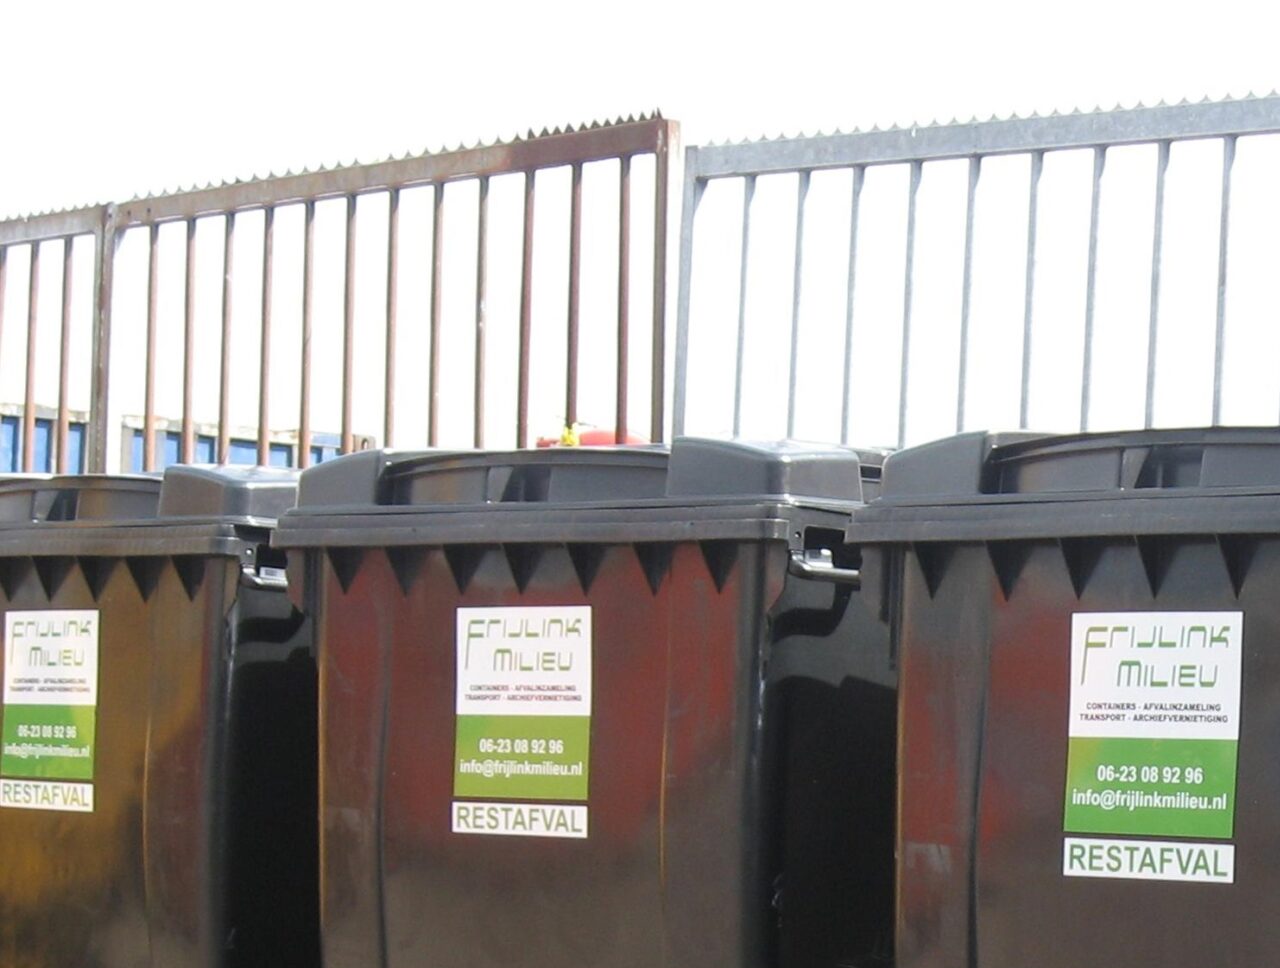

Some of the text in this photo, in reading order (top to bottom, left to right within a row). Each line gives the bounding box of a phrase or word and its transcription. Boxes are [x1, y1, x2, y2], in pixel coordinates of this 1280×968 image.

[1086, 702, 1136, 711] CONTAINERS
[1143, 703, 1221, 712] AFVALINZAMELING
[1080, 714, 1126, 722] TRANSPORT
[1133, 714, 1228, 723] ARCHIEFVERNIETIGING
[479, 738, 564, 754] 06-23 08 92 96
[1097, 765, 1204, 784] 06-23 08 92 96
[3, 783, 89, 807] RESTAFVAL
[1072, 789, 1227, 811] info@frijlinkmilieu.nl
[457, 806, 582, 832] RESTAFVAL
[1069, 844, 1228, 876] RESTAFVAL
